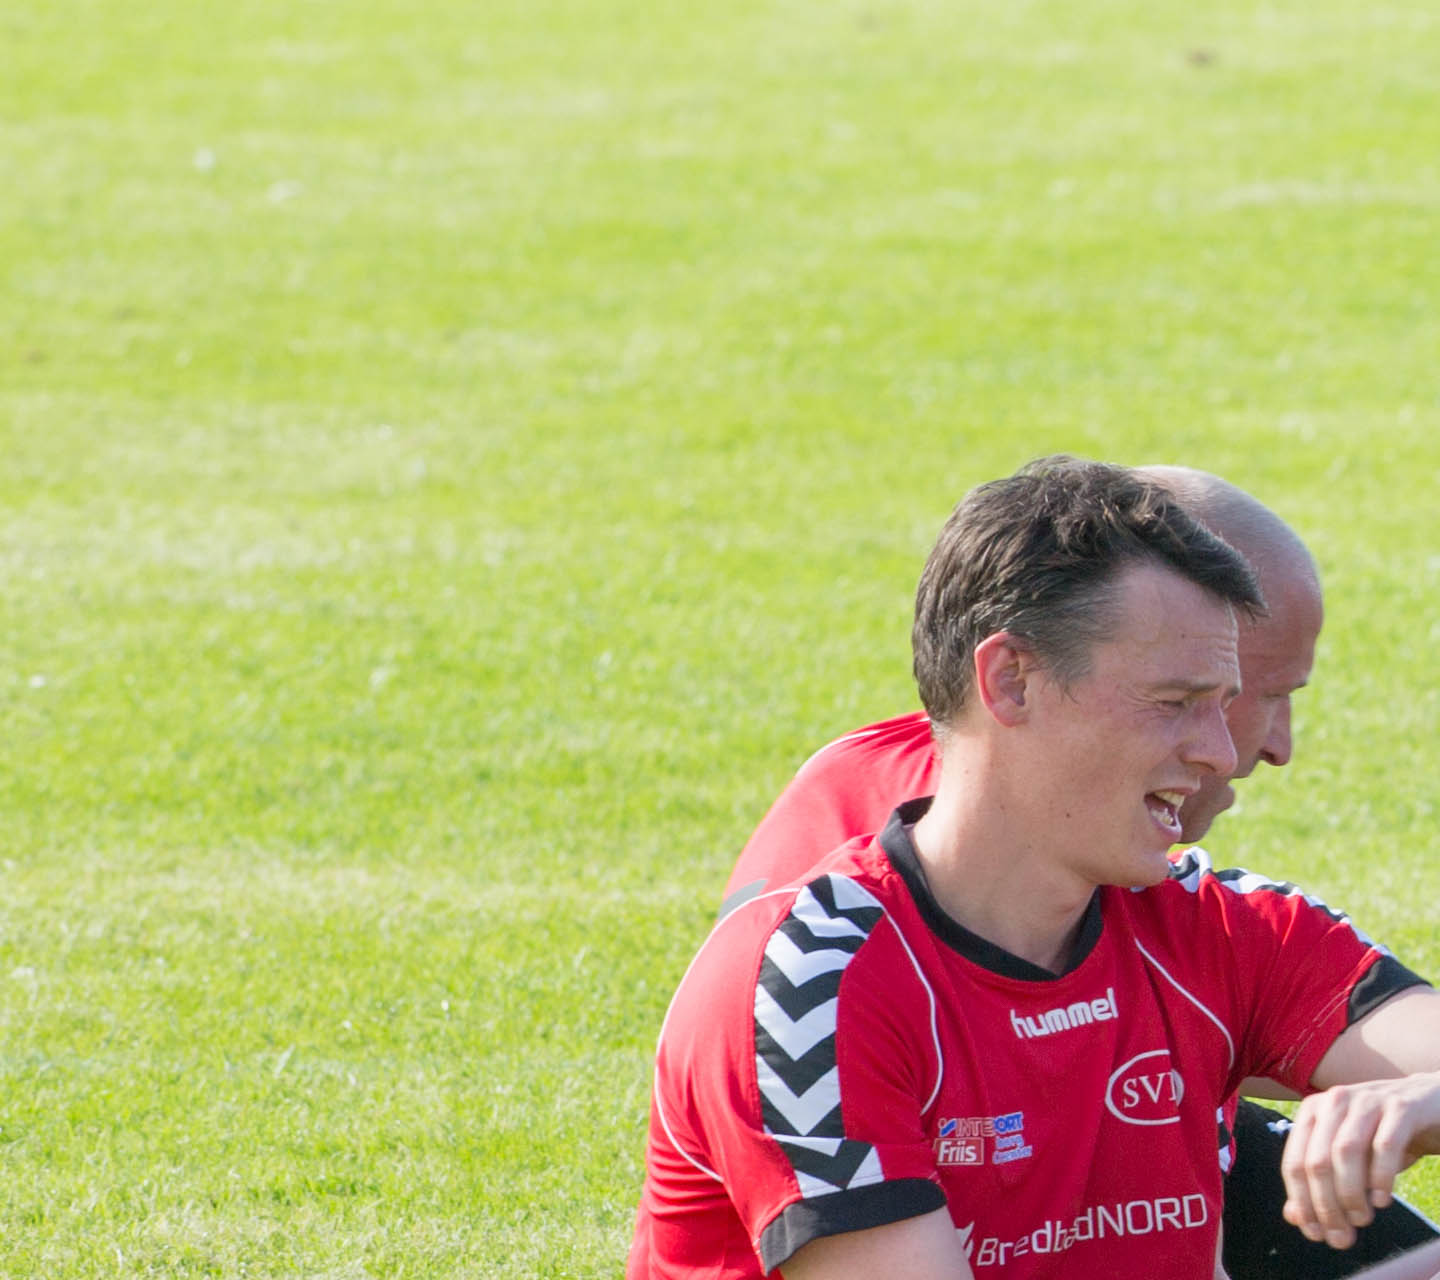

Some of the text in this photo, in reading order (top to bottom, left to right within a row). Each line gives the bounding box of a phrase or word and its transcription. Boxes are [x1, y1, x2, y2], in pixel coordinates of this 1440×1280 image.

[1010, 987, 1119, 1038] hummel
[1122, 1071, 1177, 1108] SVI
[938, 1140, 977, 1162] Friis
